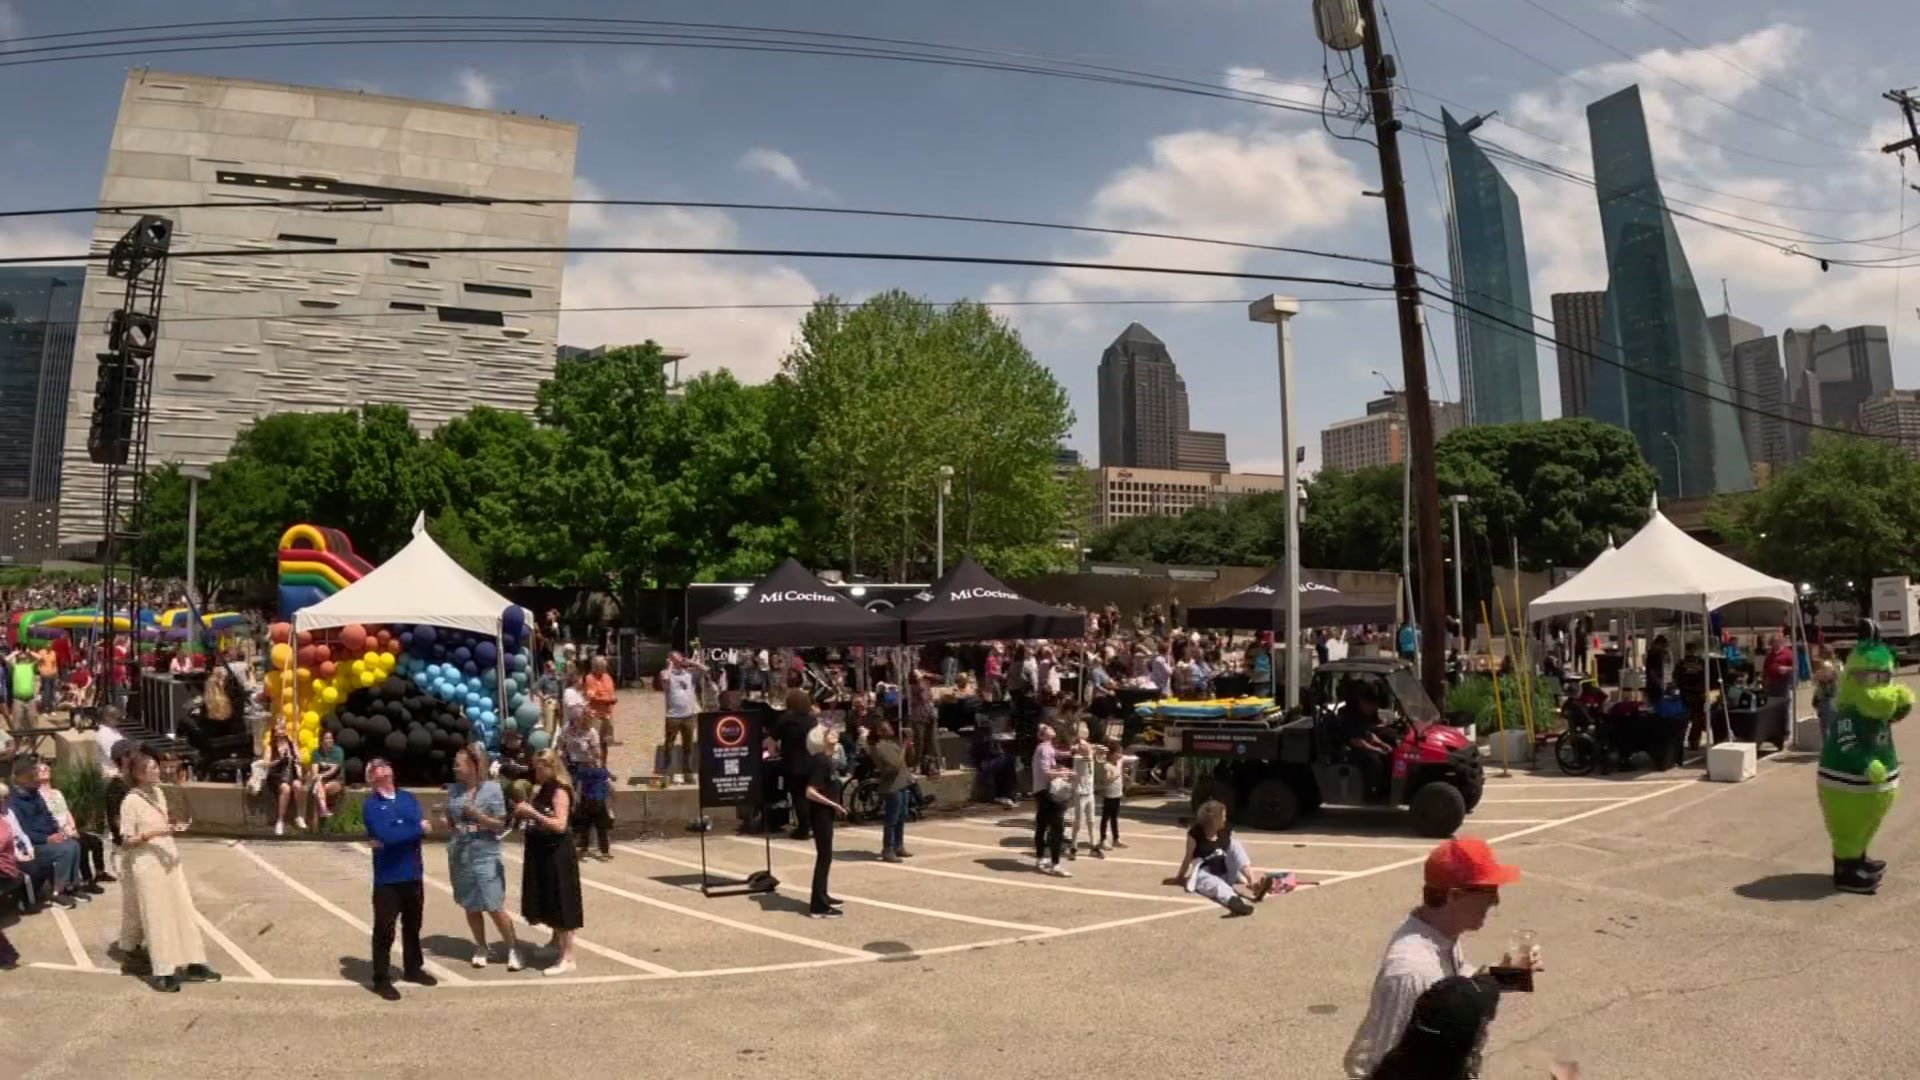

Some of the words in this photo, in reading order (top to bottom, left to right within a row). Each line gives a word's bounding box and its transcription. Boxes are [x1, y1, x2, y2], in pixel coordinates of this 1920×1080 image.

[760, 591, 783, 603] Mi
[784, 590, 836, 602] Cocina
[950, 588, 972, 601] Mi
[972, 587, 1020, 600] Cocina
